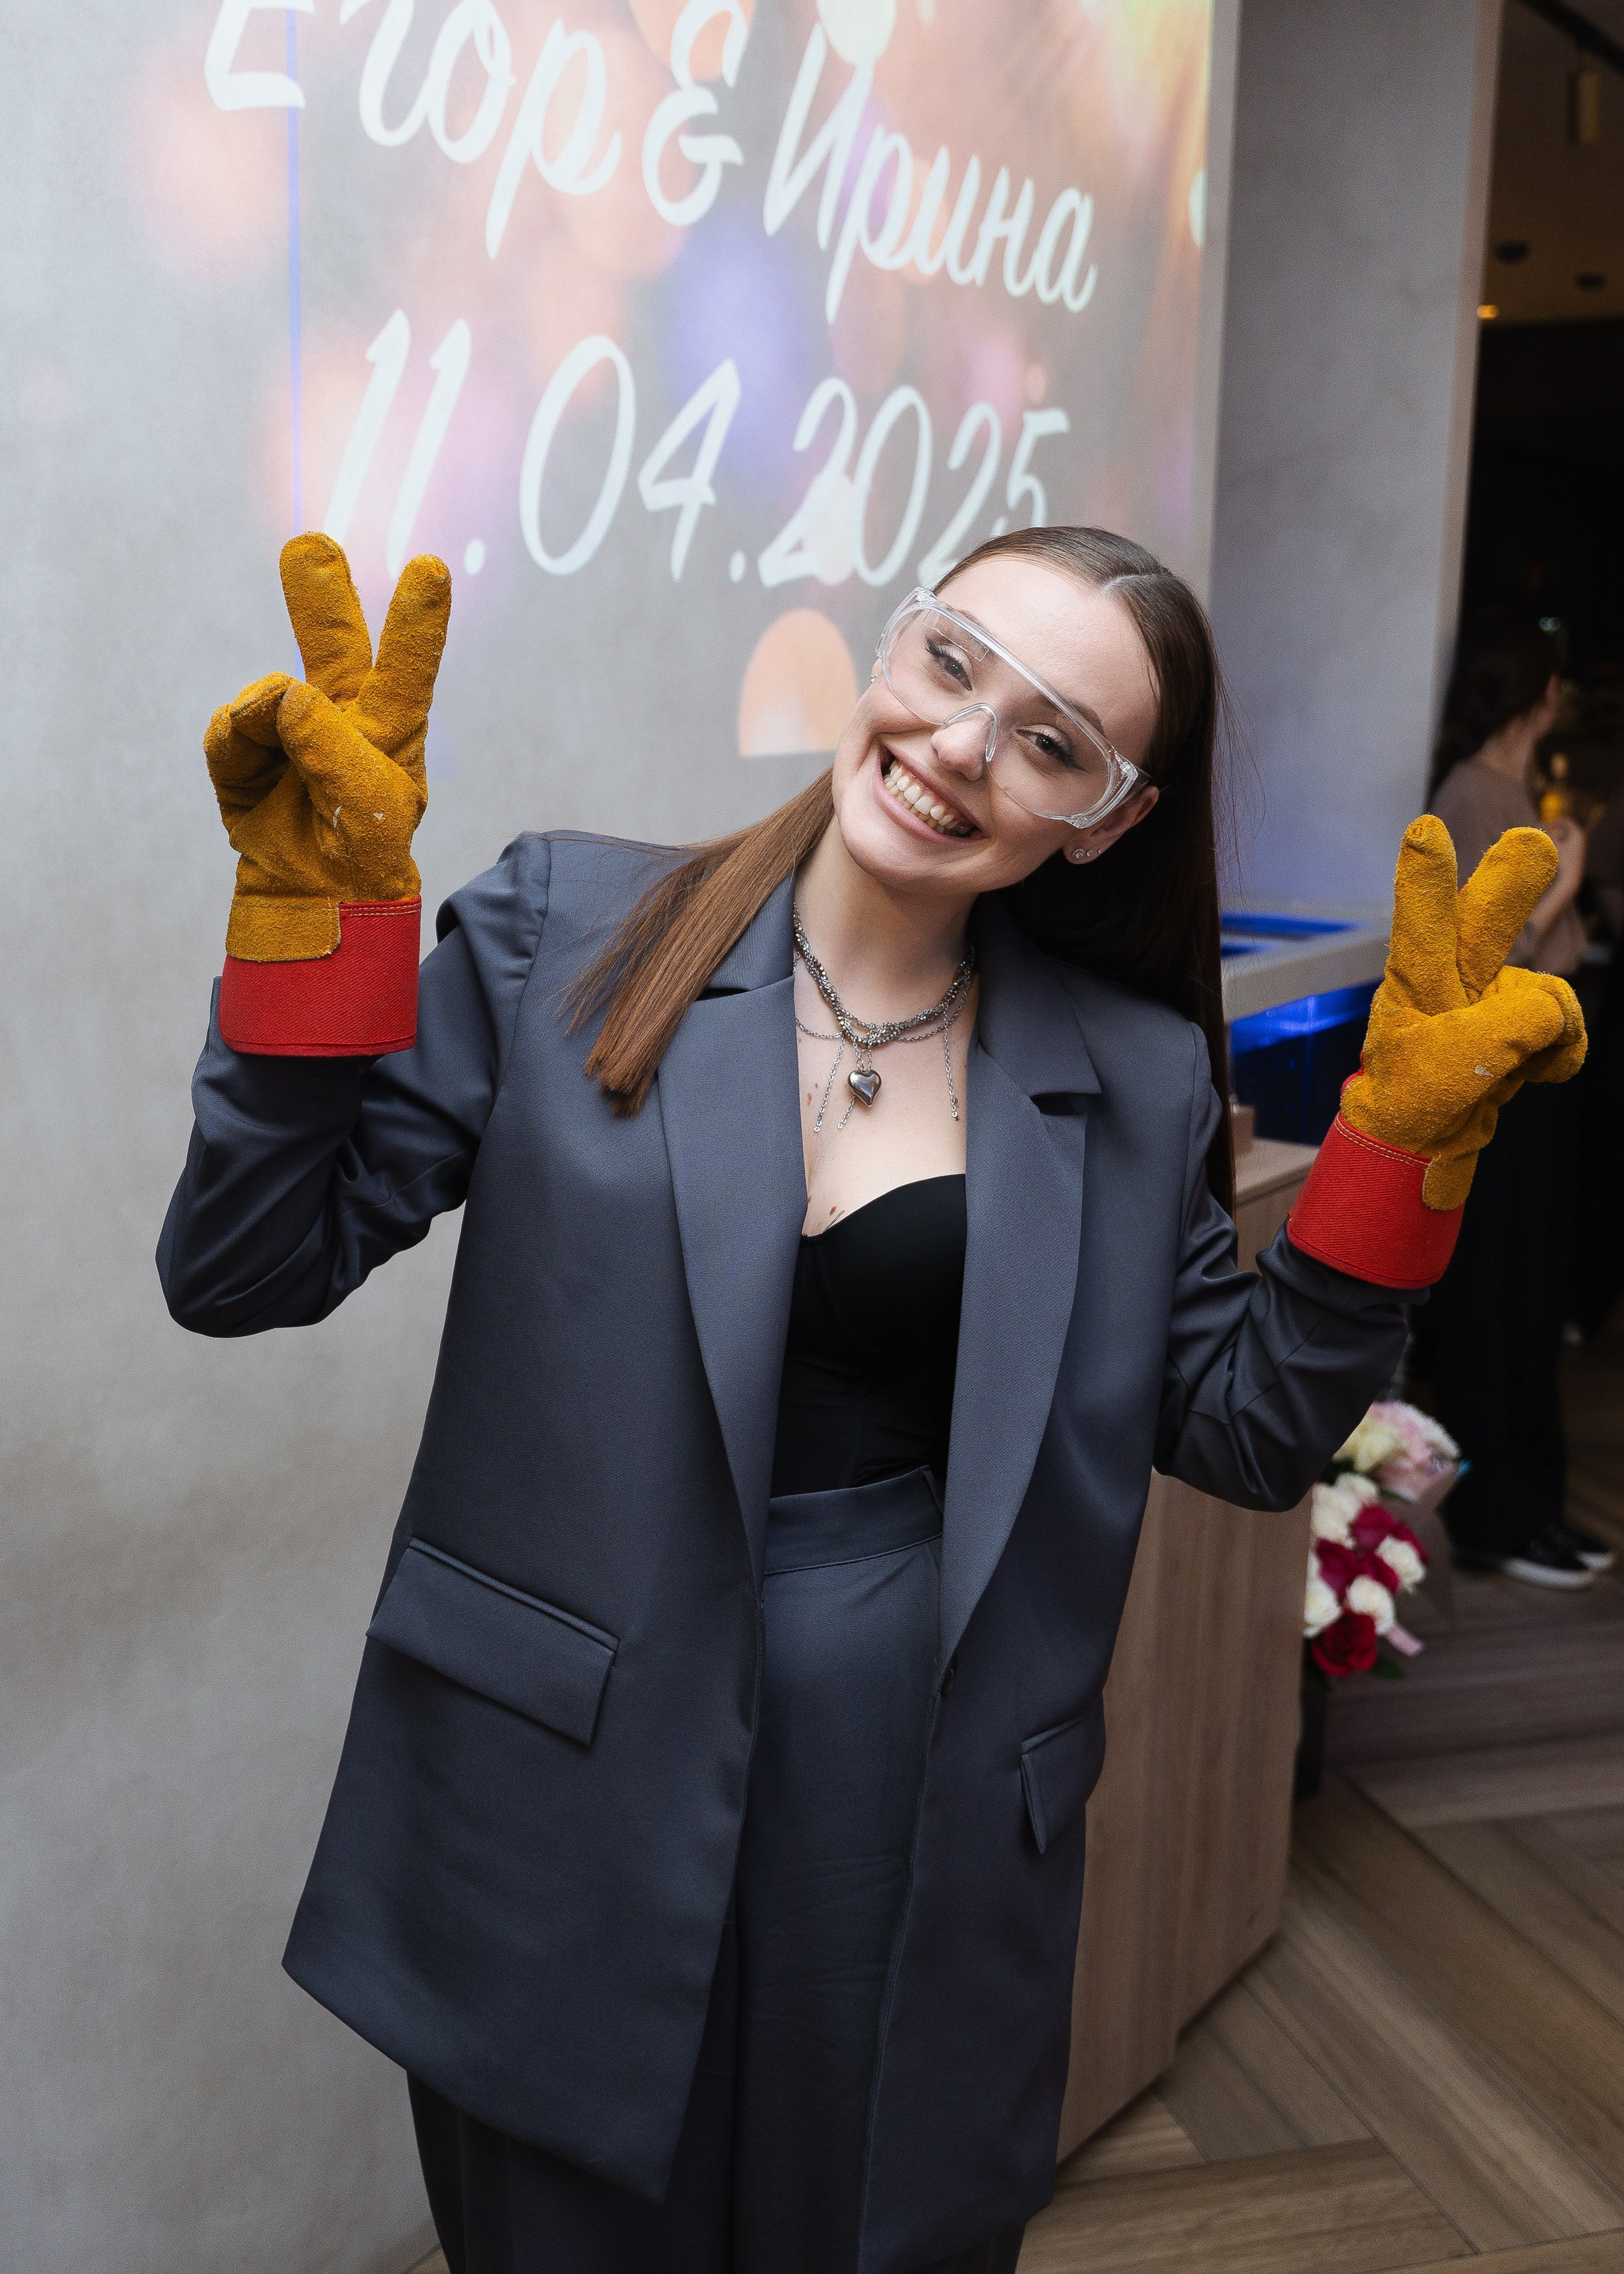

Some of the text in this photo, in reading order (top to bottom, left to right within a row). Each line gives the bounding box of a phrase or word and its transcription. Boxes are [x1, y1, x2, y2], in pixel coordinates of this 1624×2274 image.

[642, 0, 749, 227] &
[763, 22, 1097, 324] Ирина
[323, 308, 1070, 589] 11.04.2025
